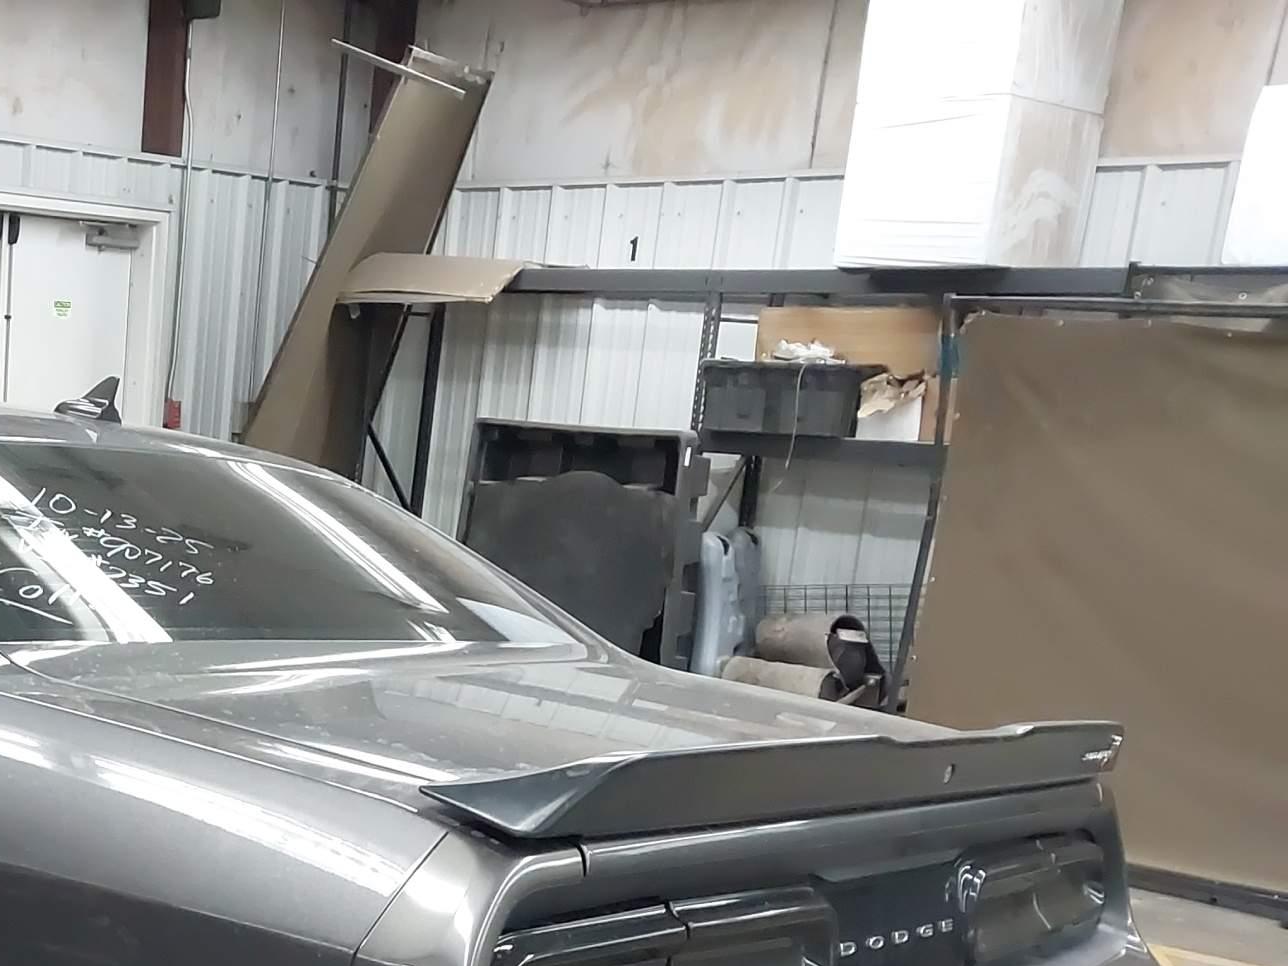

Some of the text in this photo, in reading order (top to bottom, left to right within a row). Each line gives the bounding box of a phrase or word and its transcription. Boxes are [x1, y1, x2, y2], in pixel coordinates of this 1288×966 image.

[629, 235, 640, 262] 1
[30, 487, 215, 555] 10-13-25
[839, 918, 954, 958] DODGE
